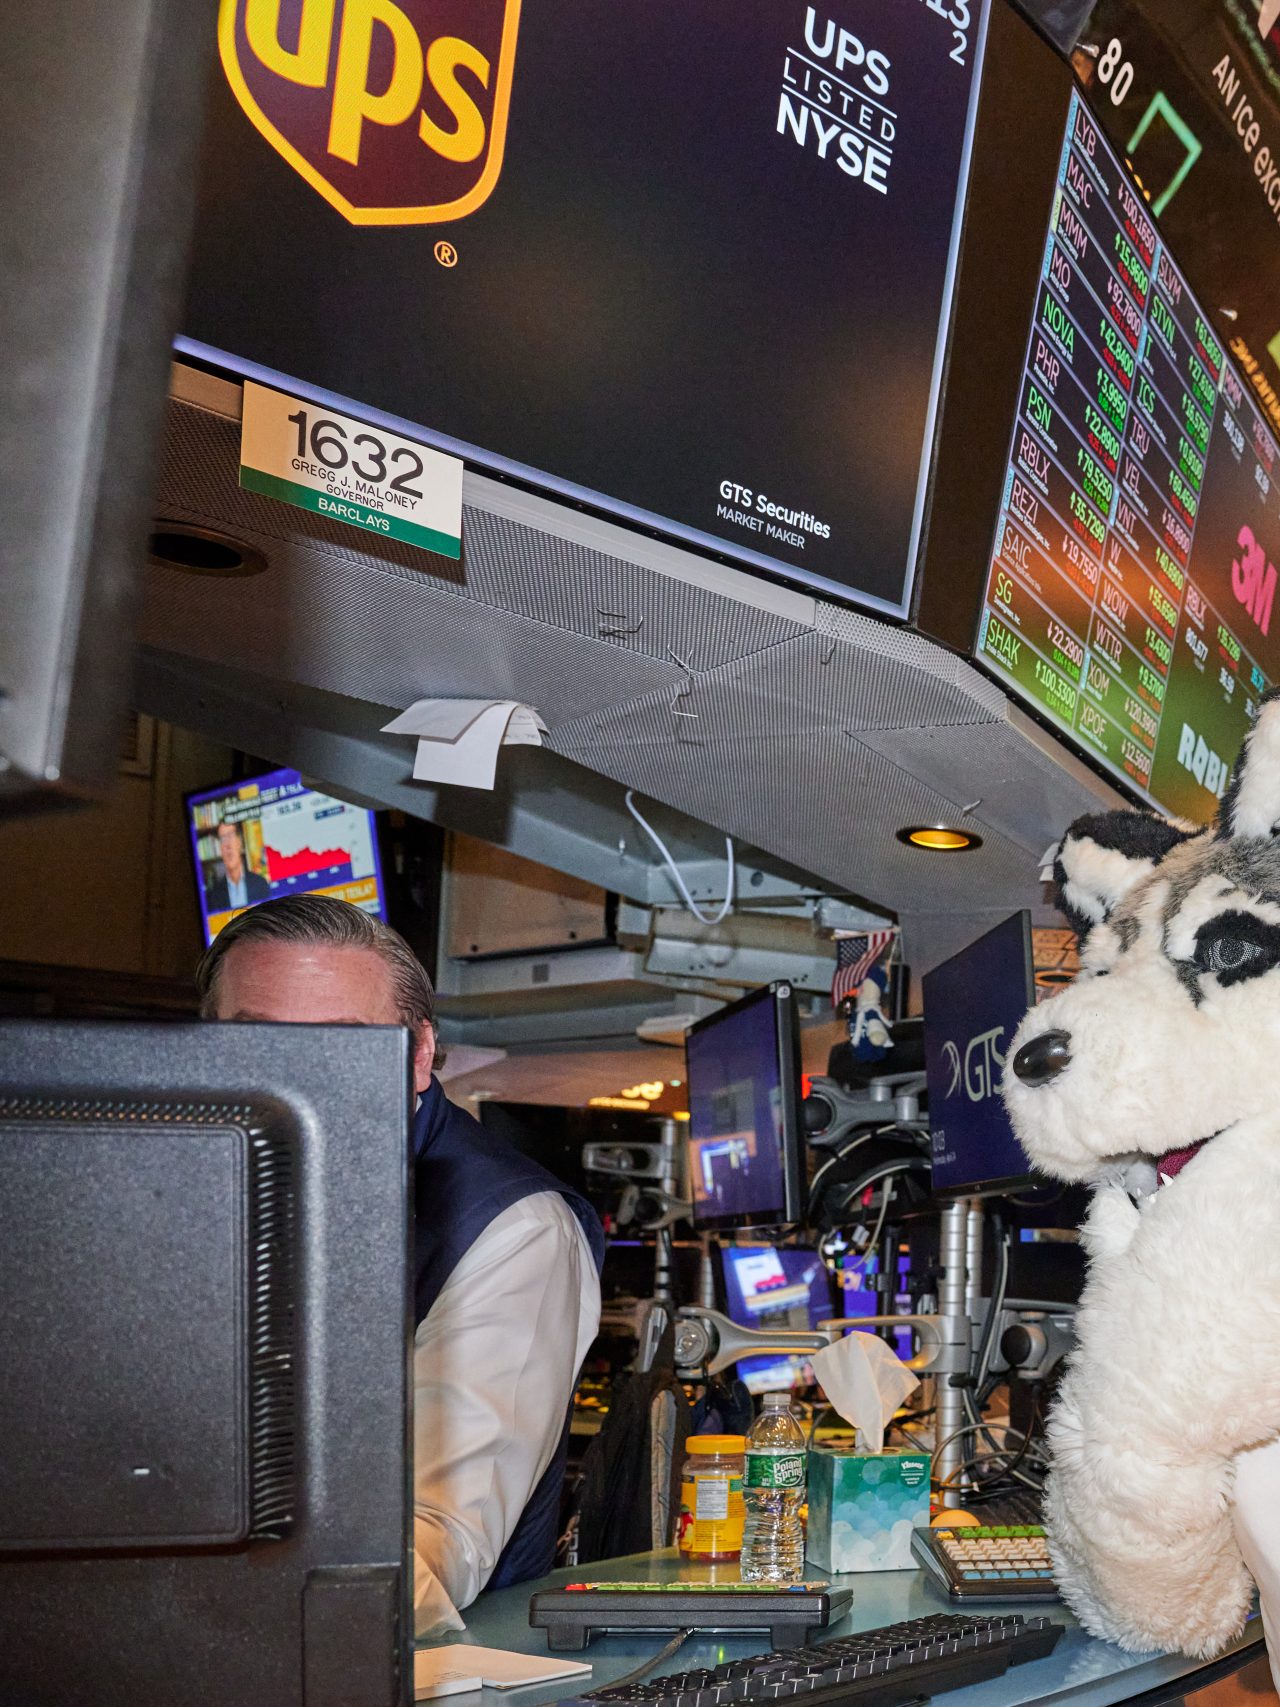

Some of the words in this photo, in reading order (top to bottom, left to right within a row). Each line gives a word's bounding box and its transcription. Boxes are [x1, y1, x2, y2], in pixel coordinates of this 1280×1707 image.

[804, 6, 891, 95] UPS
[1097, 38, 1134, 106] 80
[244, 0, 490, 167] ups
[783, 57, 896, 142] LISTED
[1212, 55, 1240, 107] AN
[776, 92, 892, 195] NYSE
[1075, 106, 1097, 160] LYB
[1122, 187, 1155, 257] 100.1650
[1067, 152, 1093, 212] MAC
[1118, 236, 1148, 298] 15.9600
[1059, 198, 1088, 260] MMM
[1111, 279, 1141, 339] 92.7800
[1158, 251, 1182, 306] SLVM
[1051, 245, 1071, 293] MO
[1103, 322, 1134, 381] 42.8400
[1151, 291, 1175, 346] STVN
[1043, 291, 1076, 355] NOVA
[1101, 371, 1127, 421] 3.9950
[1144, 332, 1153, 361] T
[1035, 337, 1060, 388] PHR
[1089, 408, 1120, 463] 22.8900
[1137, 373, 1156, 416] TCS
[288, 410, 423, 499] 1632
[1027, 384, 1052, 433] PSN
[1081, 451, 1113, 504] 79.5250
[1130, 414, 1150, 457] TRU
[291, 458, 336, 482] GREGG
[340, 476, 350, 488] J.
[356, 479, 418, 511] MALONEY
[326, 484, 384, 511] GOVERNOR
[1019, 430, 1050, 484] RBLX
[1074, 494, 1105, 546] 35.7299
[1123, 455, 1142, 495] VEL
[318, 498, 390, 531] BARCLAYS
[716, 504, 765, 533] MARKET
[766, 523, 806, 549] MAKER
[719, 480, 752, 507] GTS
[756, 495, 831, 539] Securities
[1011, 477, 1038, 525] REZI
[1066, 538, 1098, 586] 19.7550
[1116, 496, 1136, 537] VNT
[1003, 523, 1032, 571] SAIC
[1109, 536, 1122, 567] W
[1101, 577, 1129, 624] WOW
[1185, 583, 1207, 623] RBLX
[1231, 525, 1278, 637] 3M
[995, 570, 1013, 606] SG
[1051, 623, 1083, 668] 22.2900
[1094, 619, 1123, 663] WTTR
[986, 616, 1021, 665] SHAK
[1039, 663, 1076, 709] 100.3300
[1087, 660, 1110, 697] XOM
[1080, 701, 1107, 741] XPOF
[964, 1026, 1005, 1102] GTS
